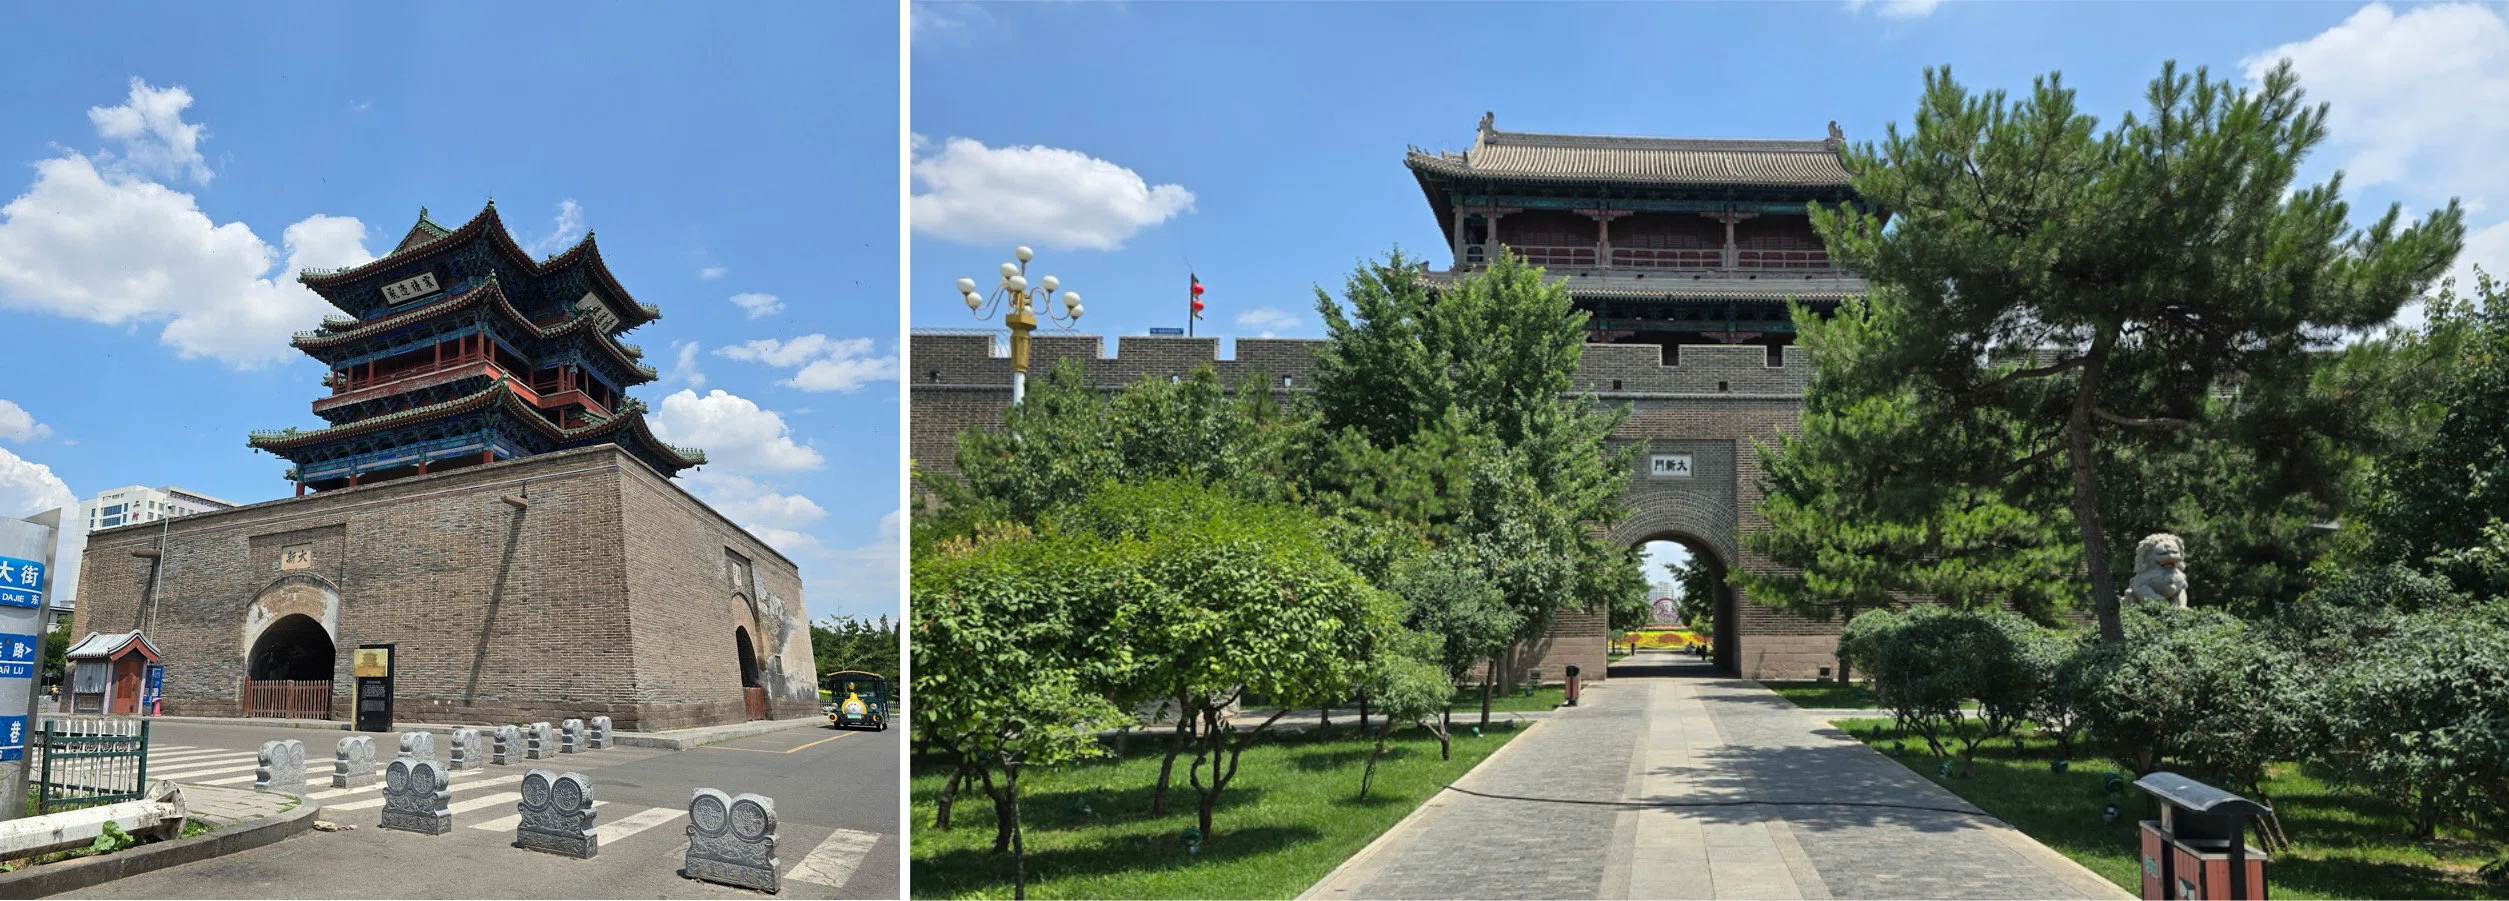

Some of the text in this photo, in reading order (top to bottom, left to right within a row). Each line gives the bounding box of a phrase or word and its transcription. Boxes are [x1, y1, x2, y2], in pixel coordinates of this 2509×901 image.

[286, 549, 308, 564] 大新
[0, 560, 39, 587] 大街
[2, 593, 25, 603] DAJIE
[13, 666, 24, 675] LU
[10, 720, 21, 744] 巷
